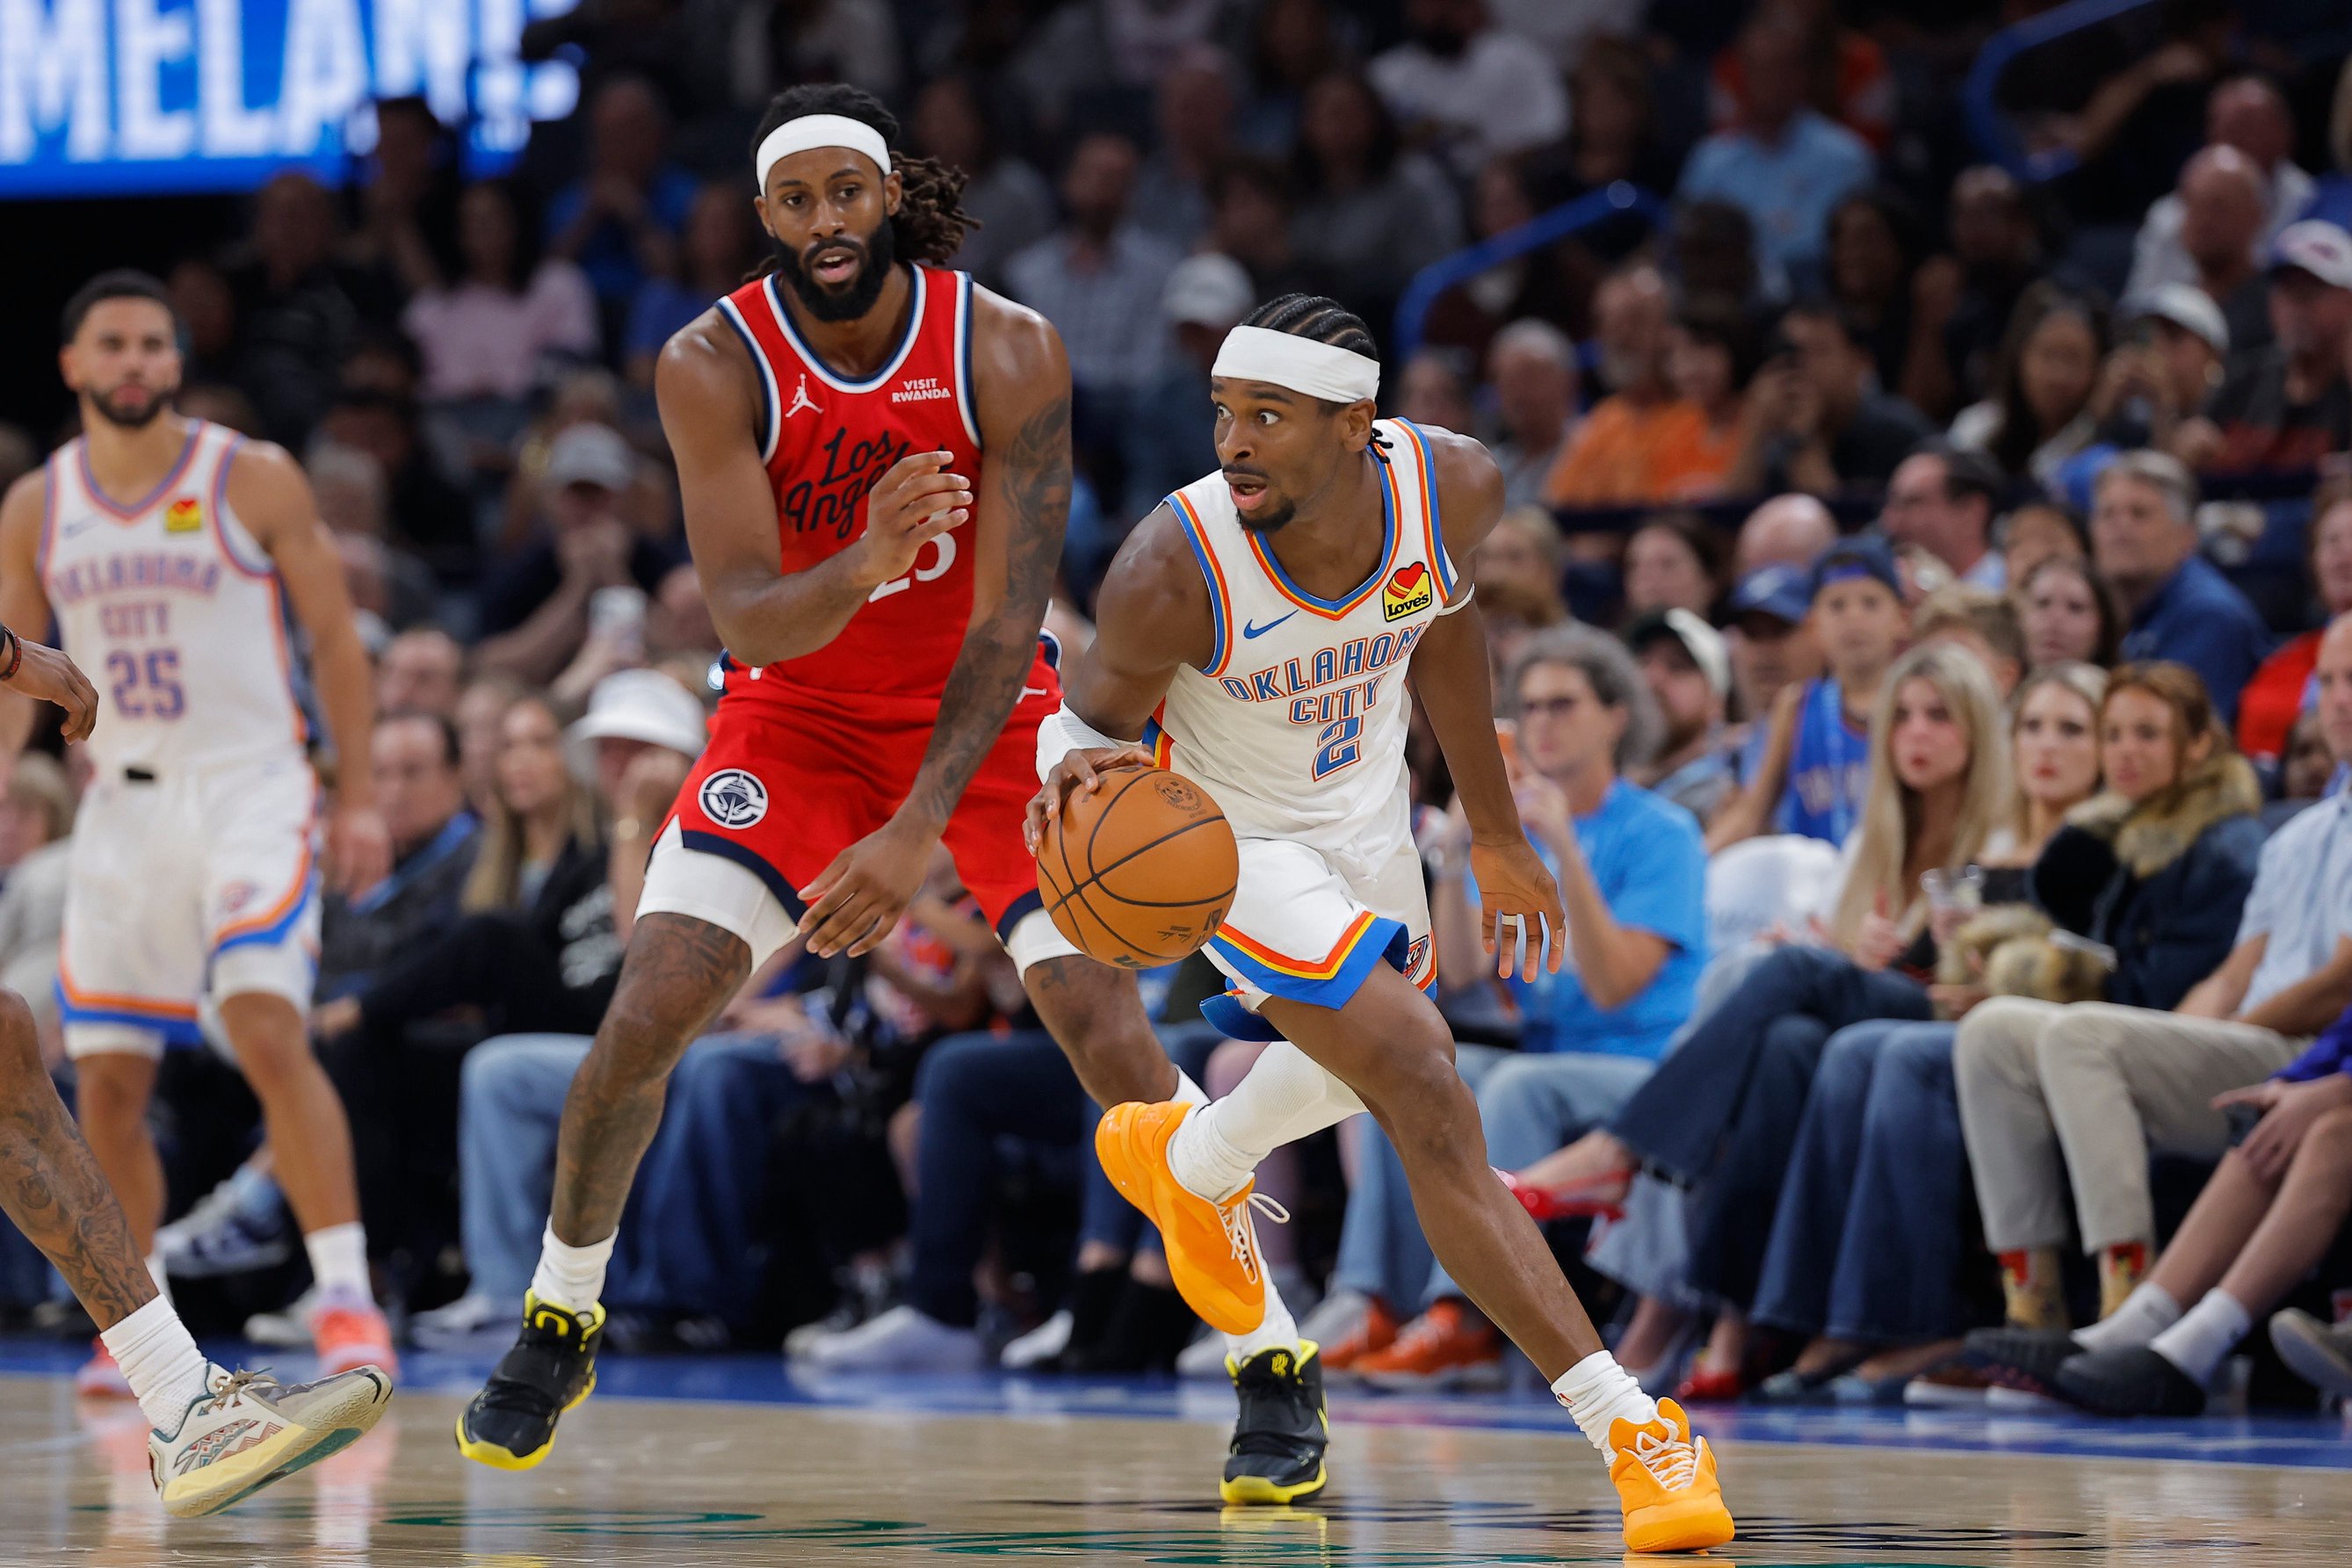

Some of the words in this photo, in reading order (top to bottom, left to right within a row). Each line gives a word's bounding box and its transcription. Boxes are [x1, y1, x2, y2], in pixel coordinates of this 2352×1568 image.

[891, 387, 951, 403] RWANDA
[902, 378, 937, 392] VISIT
[818, 427, 896, 488] Los
[105, 648, 186, 720] 25
[1219, 621, 1429, 703] OKLAHOM
[1288, 672, 1387, 725] CITY
[1312, 715, 1364, 783] 2
